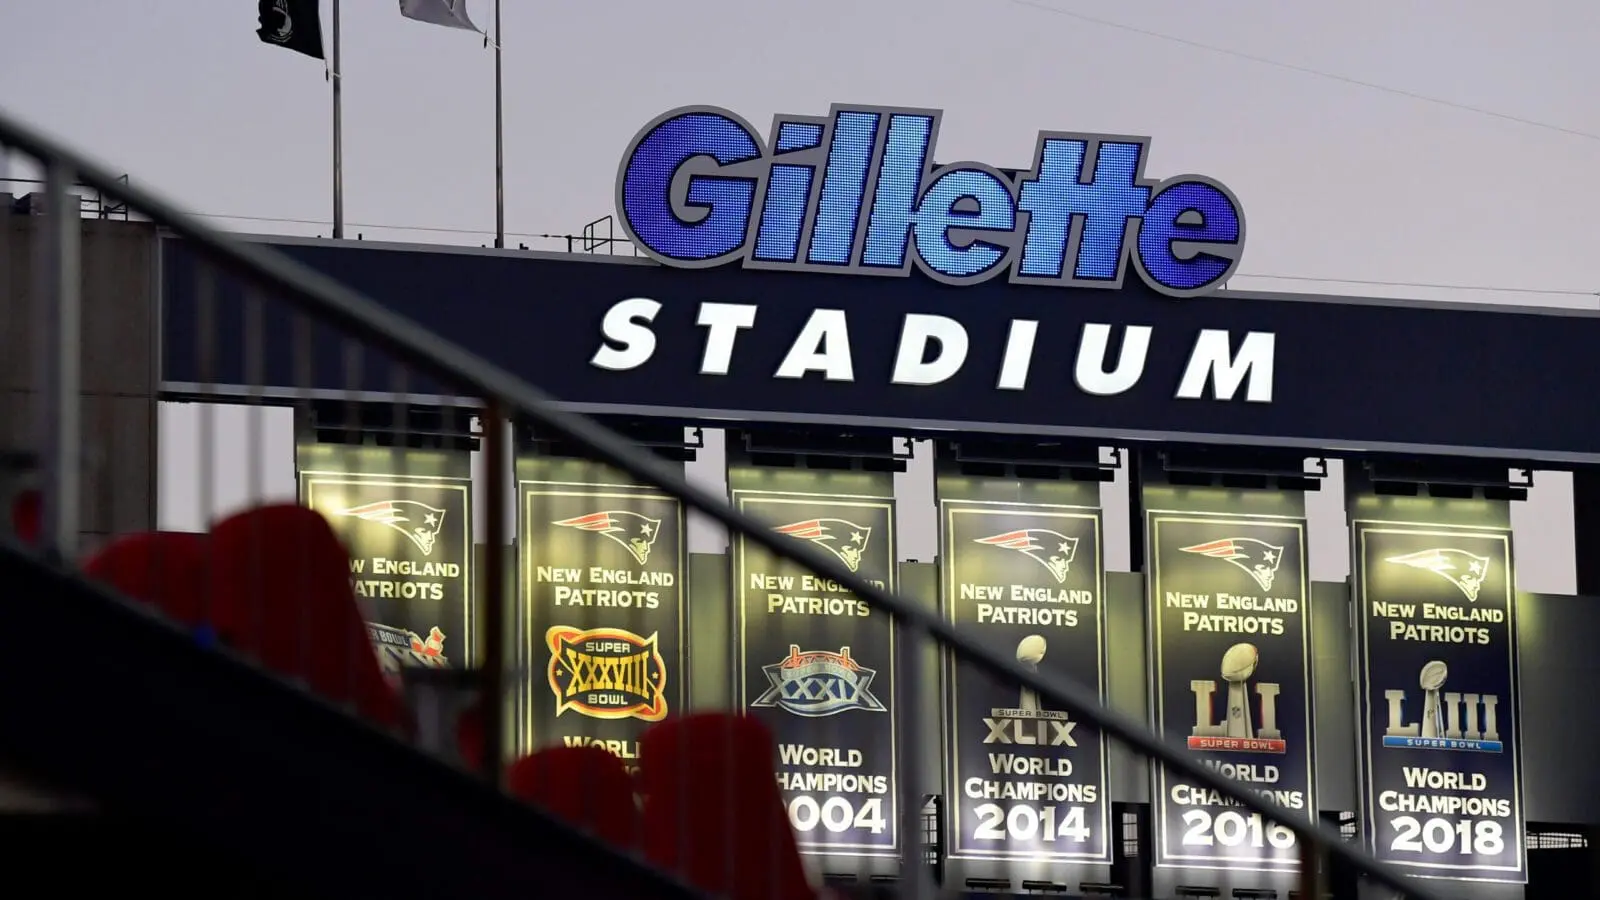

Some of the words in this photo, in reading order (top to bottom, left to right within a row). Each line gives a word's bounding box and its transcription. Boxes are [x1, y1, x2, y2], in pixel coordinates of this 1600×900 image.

[620, 108, 1241, 292] Gillette
[590, 297, 1276, 402] STADIUM
[372, 558, 460, 578] ENGLAND
[537, 566, 582, 583] NEW
[589, 566, 674, 587] ENGLAND
[349, 578, 444, 600] ATRIOTS
[750, 573, 794, 590] NEW
[554, 586, 659, 609] PATRIOTS
[767, 593, 871, 617] PATRIOTS
[960, 583, 1003, 600] NEW
[1010, 584, 1093, 605] ENGLAND
[1166, 591, 1209, 608] NEW
[1216, 592, 1298, 613] ENGLAND
[977, 603, 1078, 627] PATRIOTS
[1183, 611, 1284, 635] PATRIOTS
[1372, 600, 1416, 618] NEW
[1422, 602, 1504, 623] ENGLAND
[1390, 621, 1490, 645] PATRIOTS
[585, 641, 631, 653] SUPER
[566, 648, 650, 700] XXXVIII
[587, 693, 628, 705] BOWL
[751, 665, 888, 712] XXXIX
[998, 709, 1032, 717] SUPER
[1035, 710, 1064, 718] BOWL
[1190, 680, 1281, 740] LI
[1384, 689, 1499, 741] LIII
[982, 717, 1078, 748] XLIX
[1200, 739, 1239, 748] SUPER
[1243, 741, 1275, 750] BOWL
[1406, 739, 1446, 748] SUPER
[1450, 741, 1481, 749] BOWL
[778, 743, 863, 767] WORLD
[988, 752, 1073, 777] WORLD
[774, 771, 888, 794] HAMPIONS
[964, 776, 1097, 803] CHAMPIONS
[1402, 766, 1487, 791] WORLD
[782, 795, 886, 834] 004
[1379, 790, 1511, 817] CHAMPIONS
[973, 803, 1091, 843] 2014
[1182, 809, 1297, 849] 2016
[1390, 816, 1505, 855] 2018
